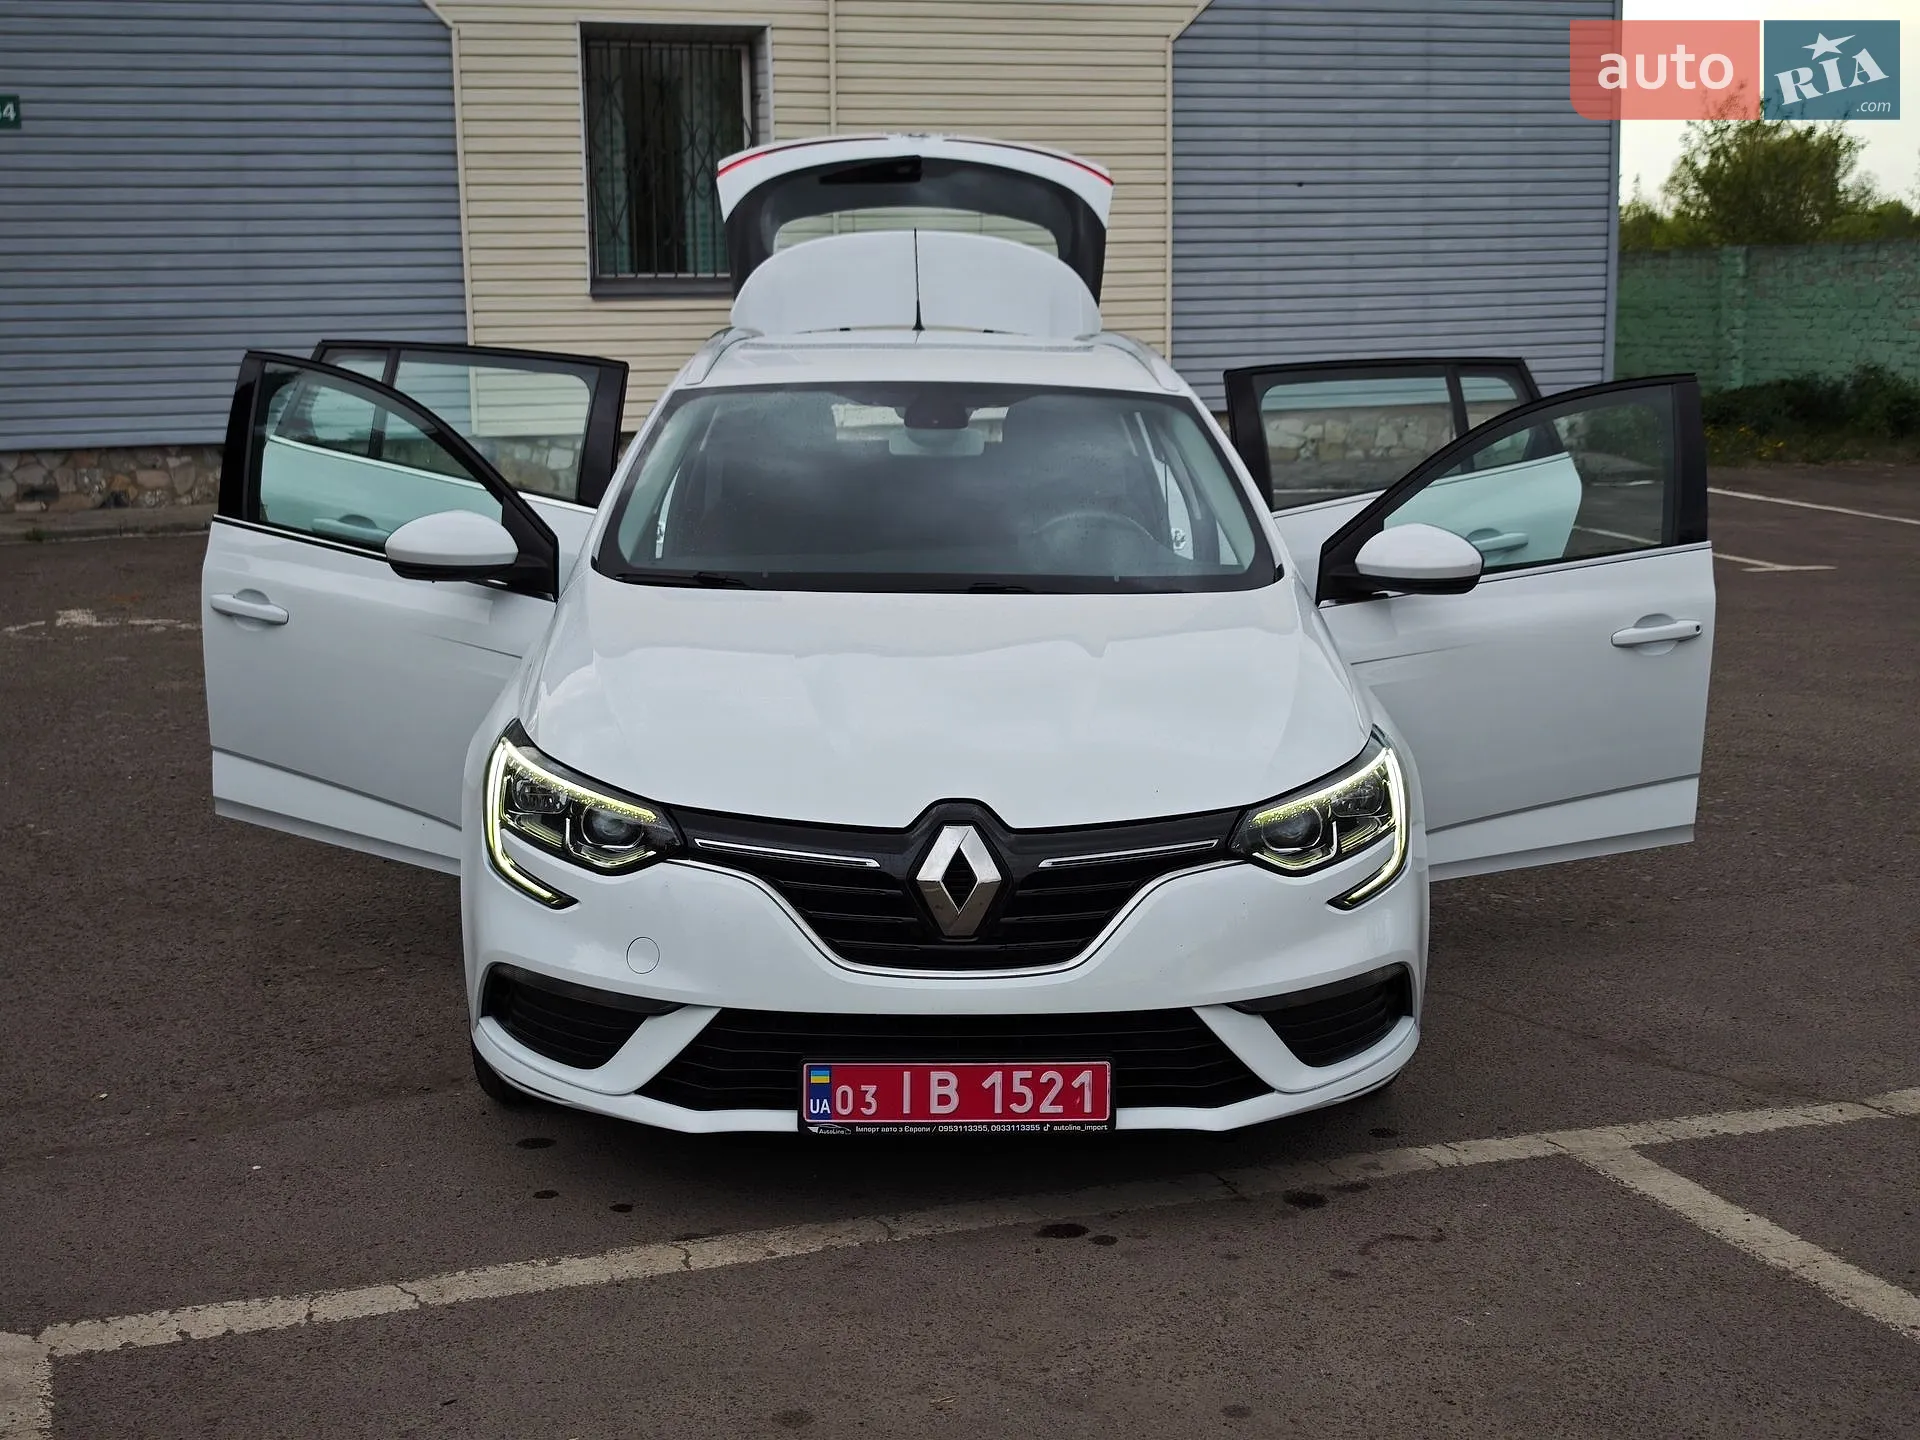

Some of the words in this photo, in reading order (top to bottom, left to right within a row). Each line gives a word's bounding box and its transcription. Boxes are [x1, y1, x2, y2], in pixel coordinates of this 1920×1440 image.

[810, 1099, 831, 1114] UA
[835, 1085, 878, 1116] 03
[981, 1070, 1094, 1114] 1521
